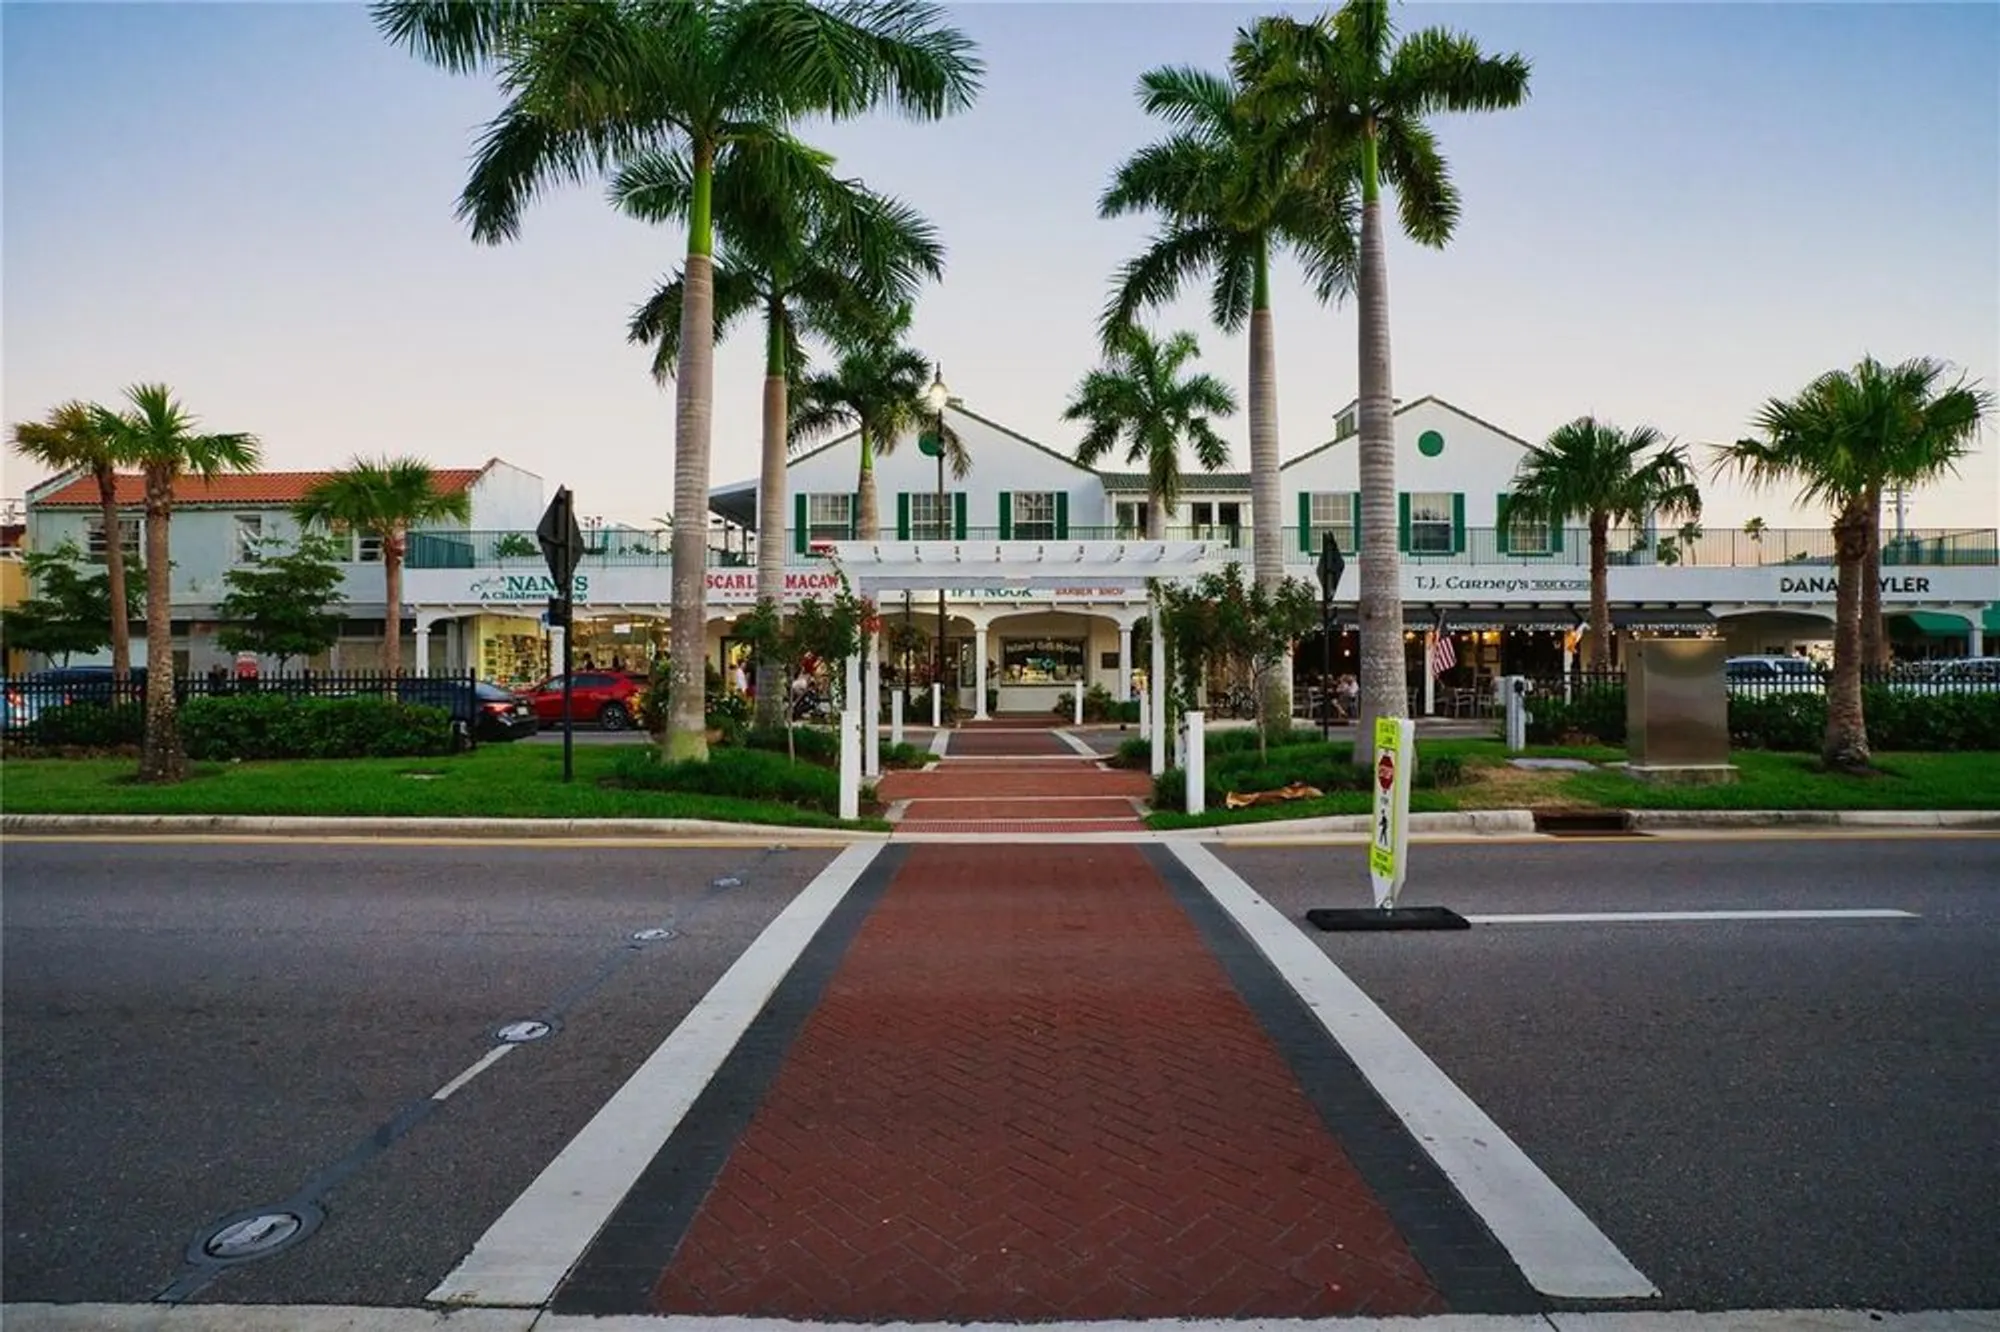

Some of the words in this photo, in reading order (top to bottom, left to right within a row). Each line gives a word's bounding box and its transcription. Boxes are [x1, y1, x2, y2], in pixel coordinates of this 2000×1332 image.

[705, 574, 757, 589] SCARL
[785, 574, 839, 589] MACAW
[1446, 576, 1529, 592] Carney's
[1780, 577, 1839, 593] DANA
[1880, 577, 1930, 593] YLER
